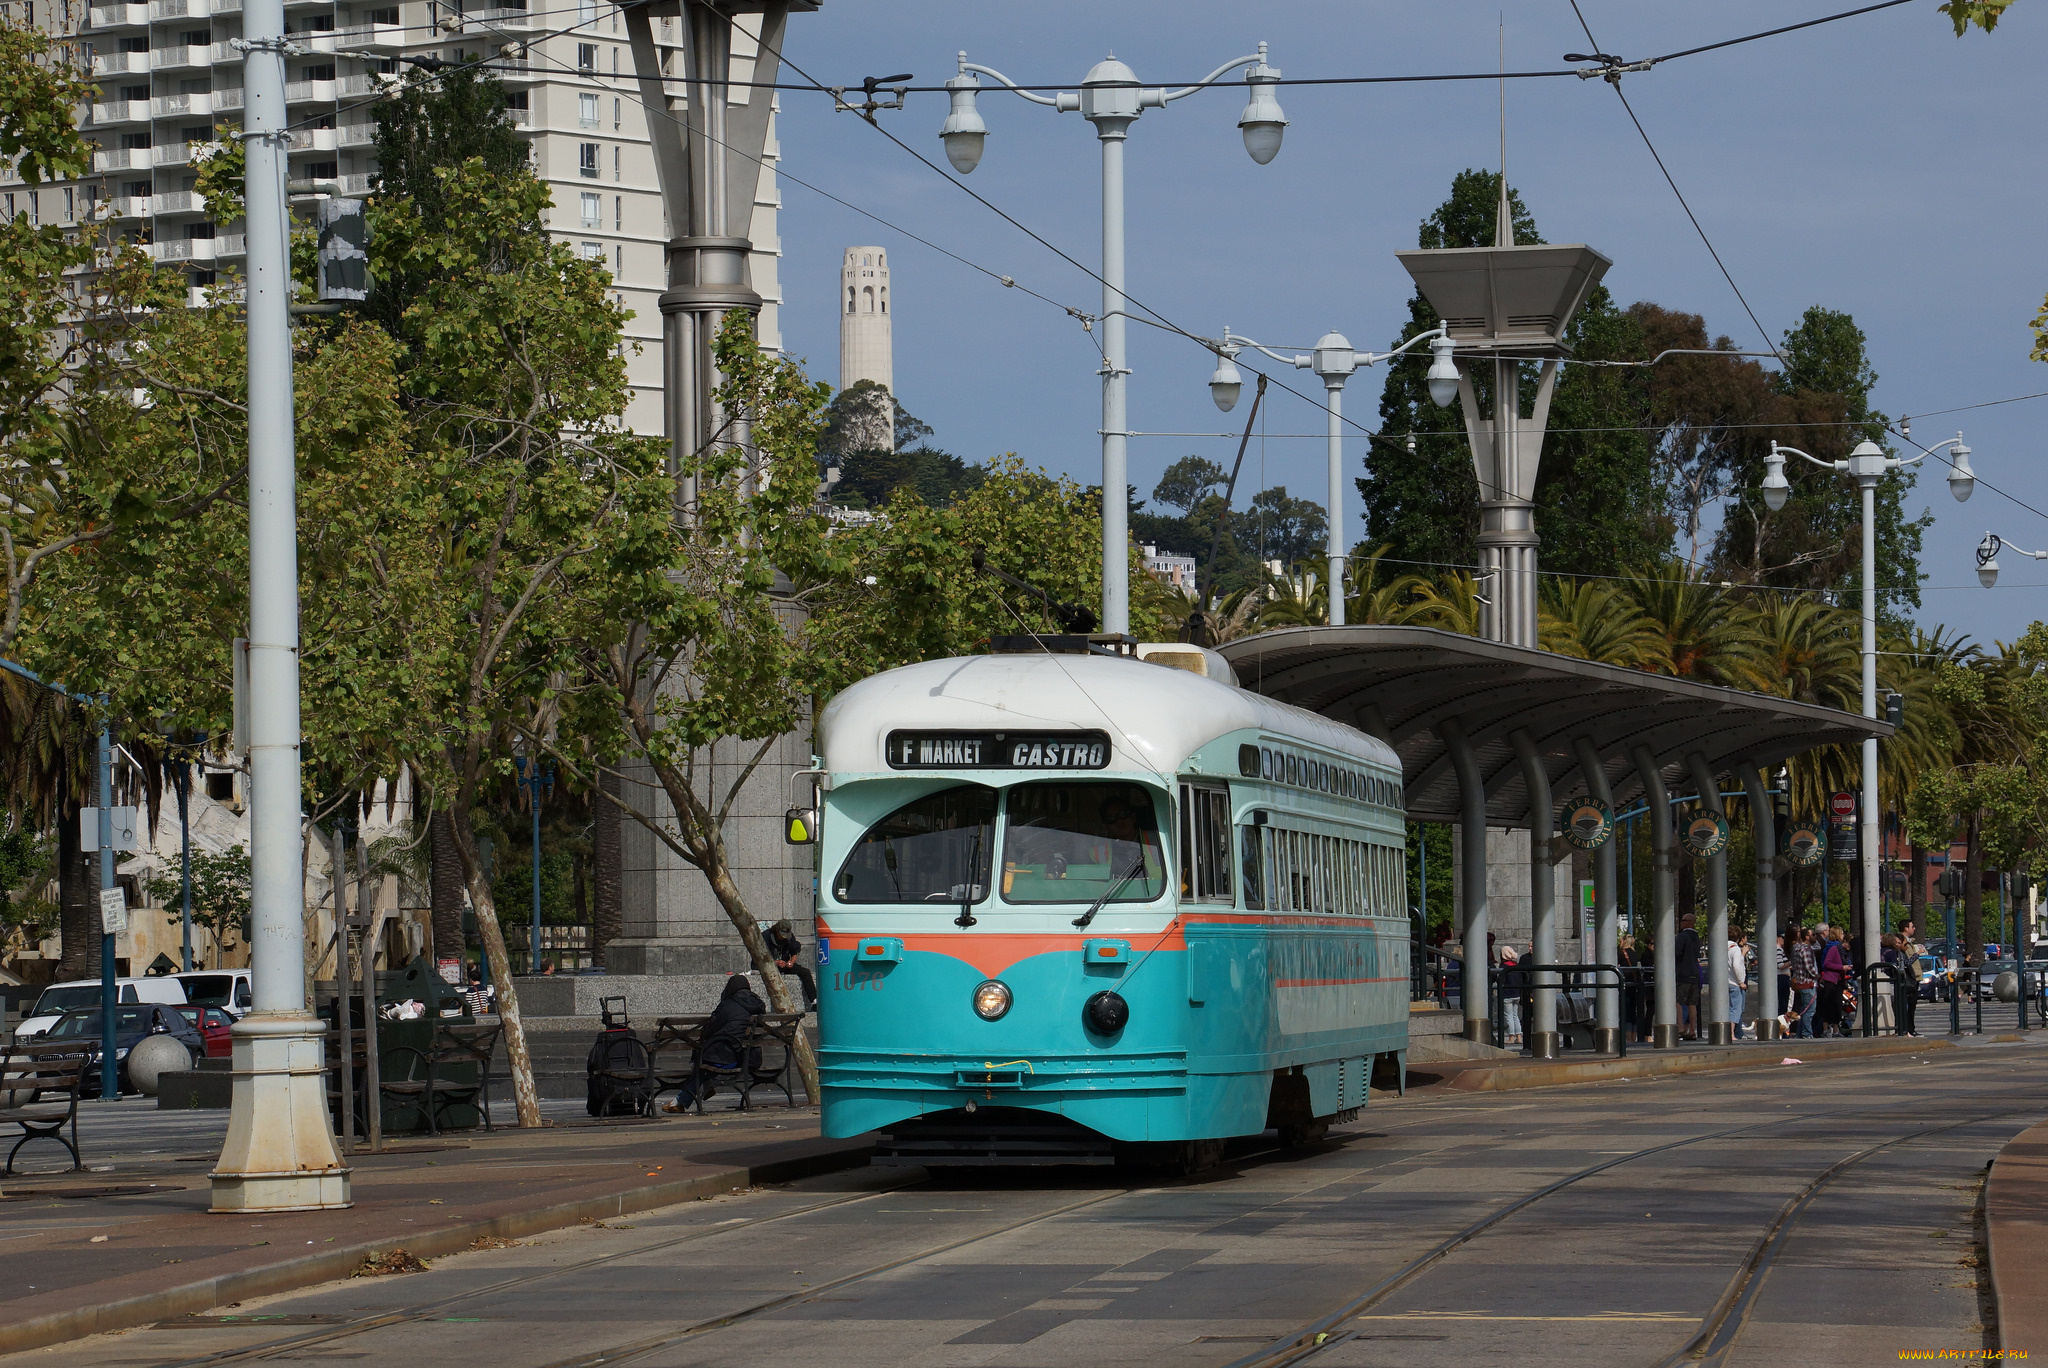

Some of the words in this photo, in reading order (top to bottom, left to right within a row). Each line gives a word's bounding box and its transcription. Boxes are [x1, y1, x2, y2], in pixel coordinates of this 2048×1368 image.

[903, 740, 913, 764] F
[920, 740, 982, 764] MARKET
[1012, 743, 1104, 766] CASTRO
[1569, 797, 1606, 811] FERRY
[1688, 810, 1720, 823] FERRY
[1564, 825, 1612, 848] TERMINAL
[1788, 823, 1820, 834] FERRY
[1682, 836, 1727, 857] TERMINAL
[1784, 845, 1825, 865] TERMINAL
[833, 971, 885, 992] 1076
